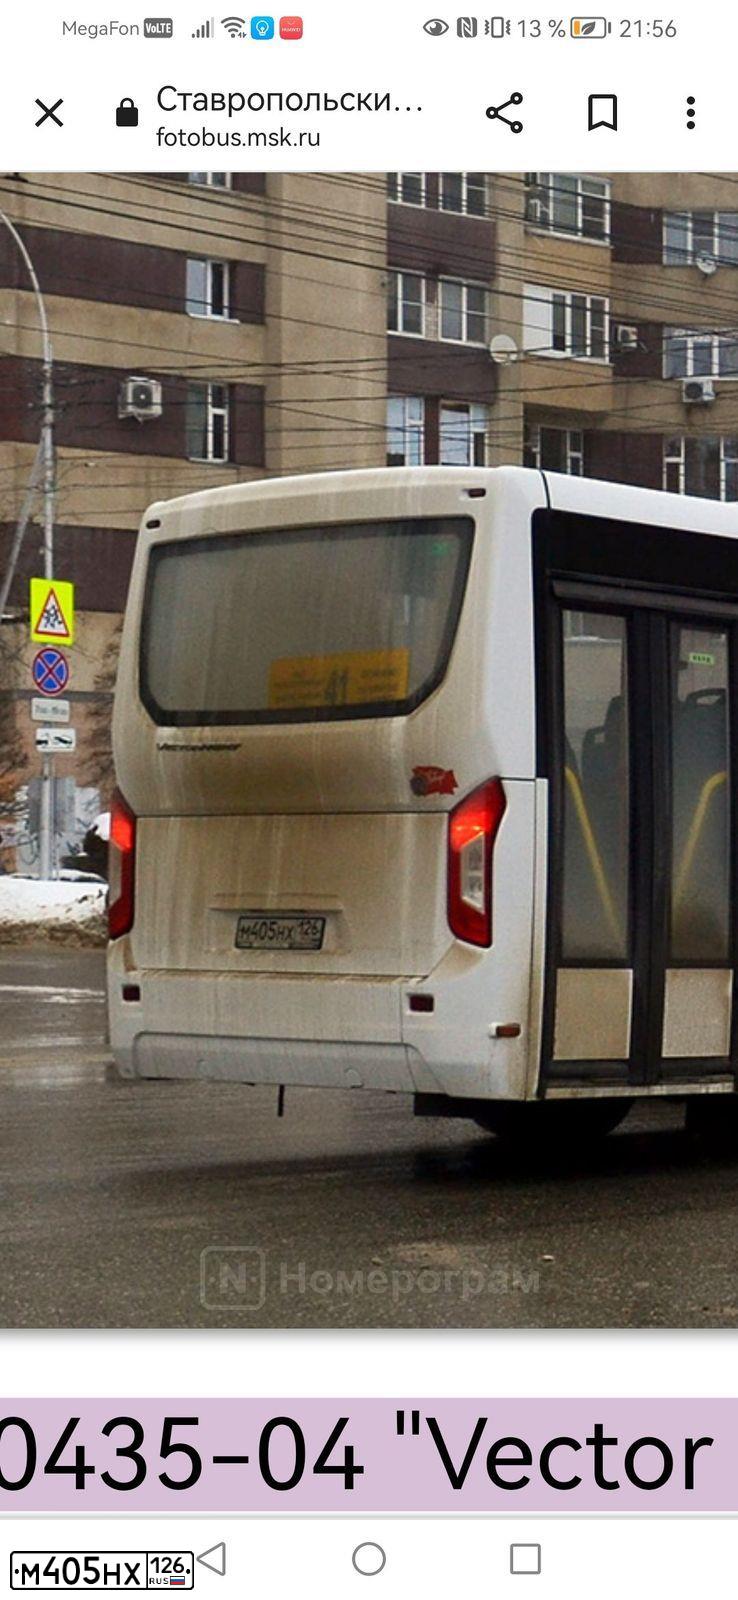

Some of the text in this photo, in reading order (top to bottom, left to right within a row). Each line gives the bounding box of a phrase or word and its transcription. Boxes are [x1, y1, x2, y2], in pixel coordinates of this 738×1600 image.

[62, 20, 140, 39] MegaFon
[145, 22, 172, 34] VoLTE
[517, 19, 542, 38] 13
[619, 19, 677, 38] 21:56
[155, 126, 320, 147] fotobus.msk.ru
[297, 919, 319, 936] 126
[0, 1410, 714, 1491] 0435-04 "Vector
